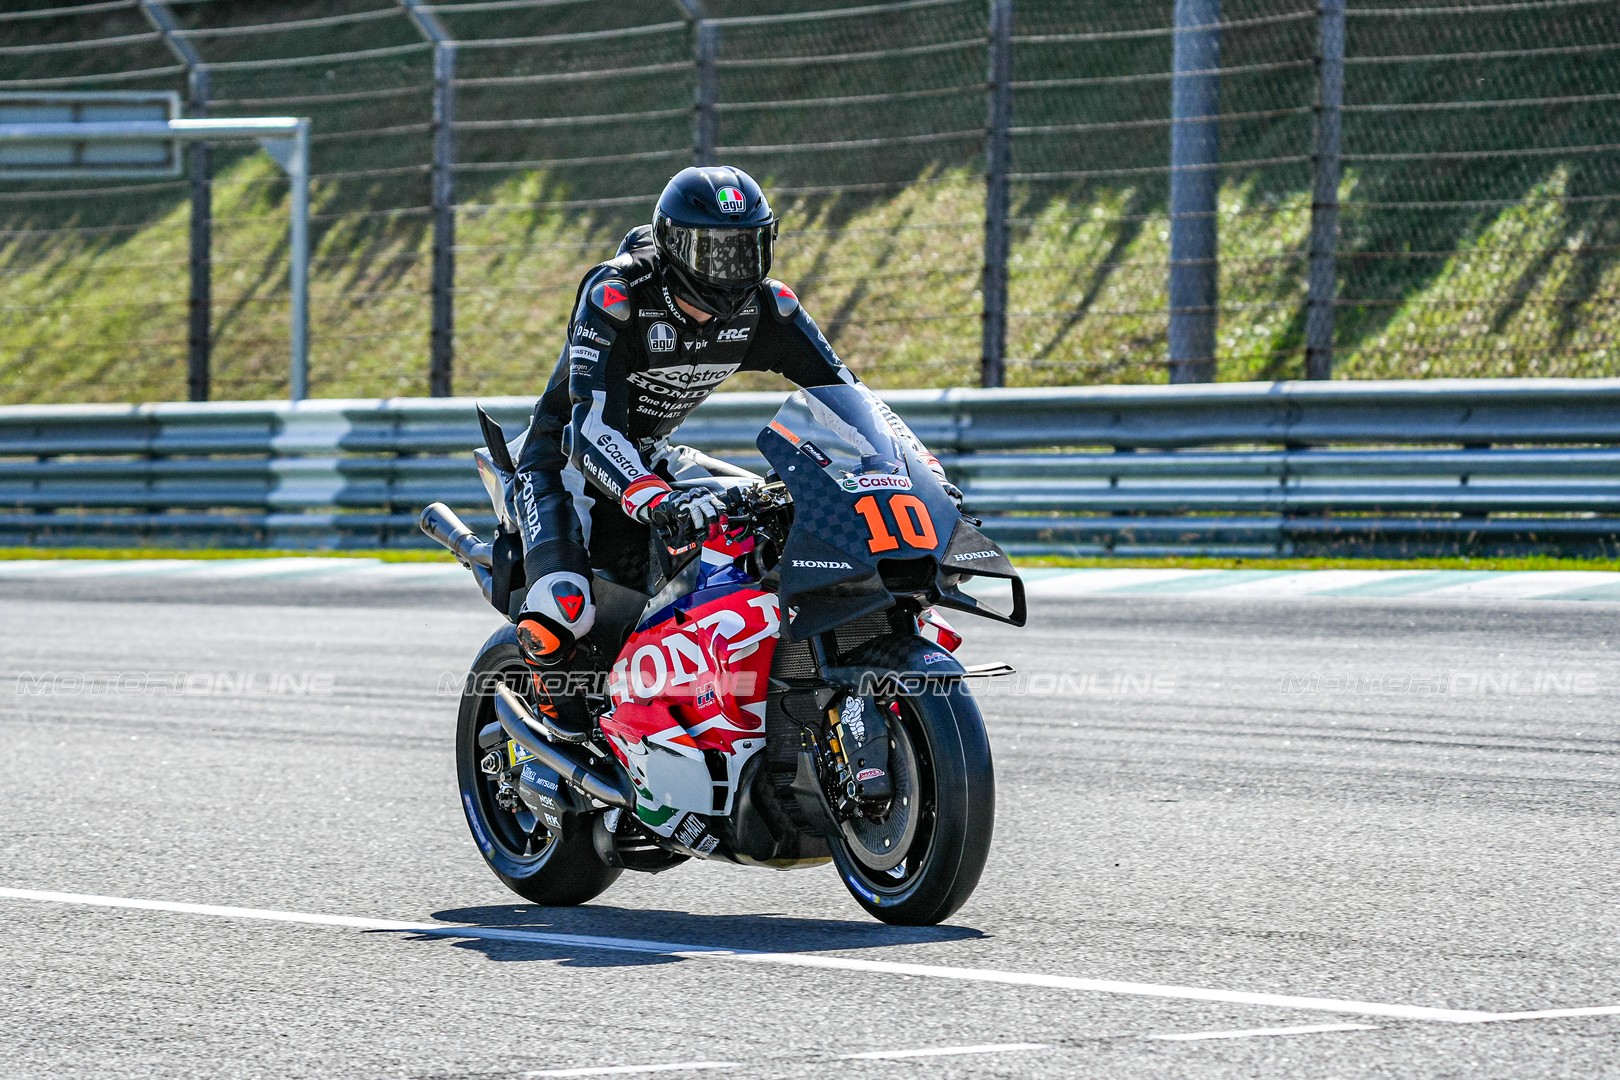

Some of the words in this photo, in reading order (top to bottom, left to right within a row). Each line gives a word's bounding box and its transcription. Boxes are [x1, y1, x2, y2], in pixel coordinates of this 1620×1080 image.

[722, 200, 743, 212] agv
[662, 286, 687, 324] HONDA
[718, 327, 751, 340] HRC
[652, 339, 674, 351] agv
[664, 367, 734, 384] Castrol
[626, 372, 714, 399] HOND
[638, 395, 660, 407] One
[636, 405, 658, 416] Satu
[605, 443, 645, 480] Castrol
[584, 453, 598, 475] One
[597, 467, 622, 497] HEART
[859, 476, 911, 489] Castrol
[518, 470, 542, 543] HONDA
[853, 493, 940, 554] 10
[953, 550, 1001, 562] HONDA
[791, 559, 853, 570] HONDA
